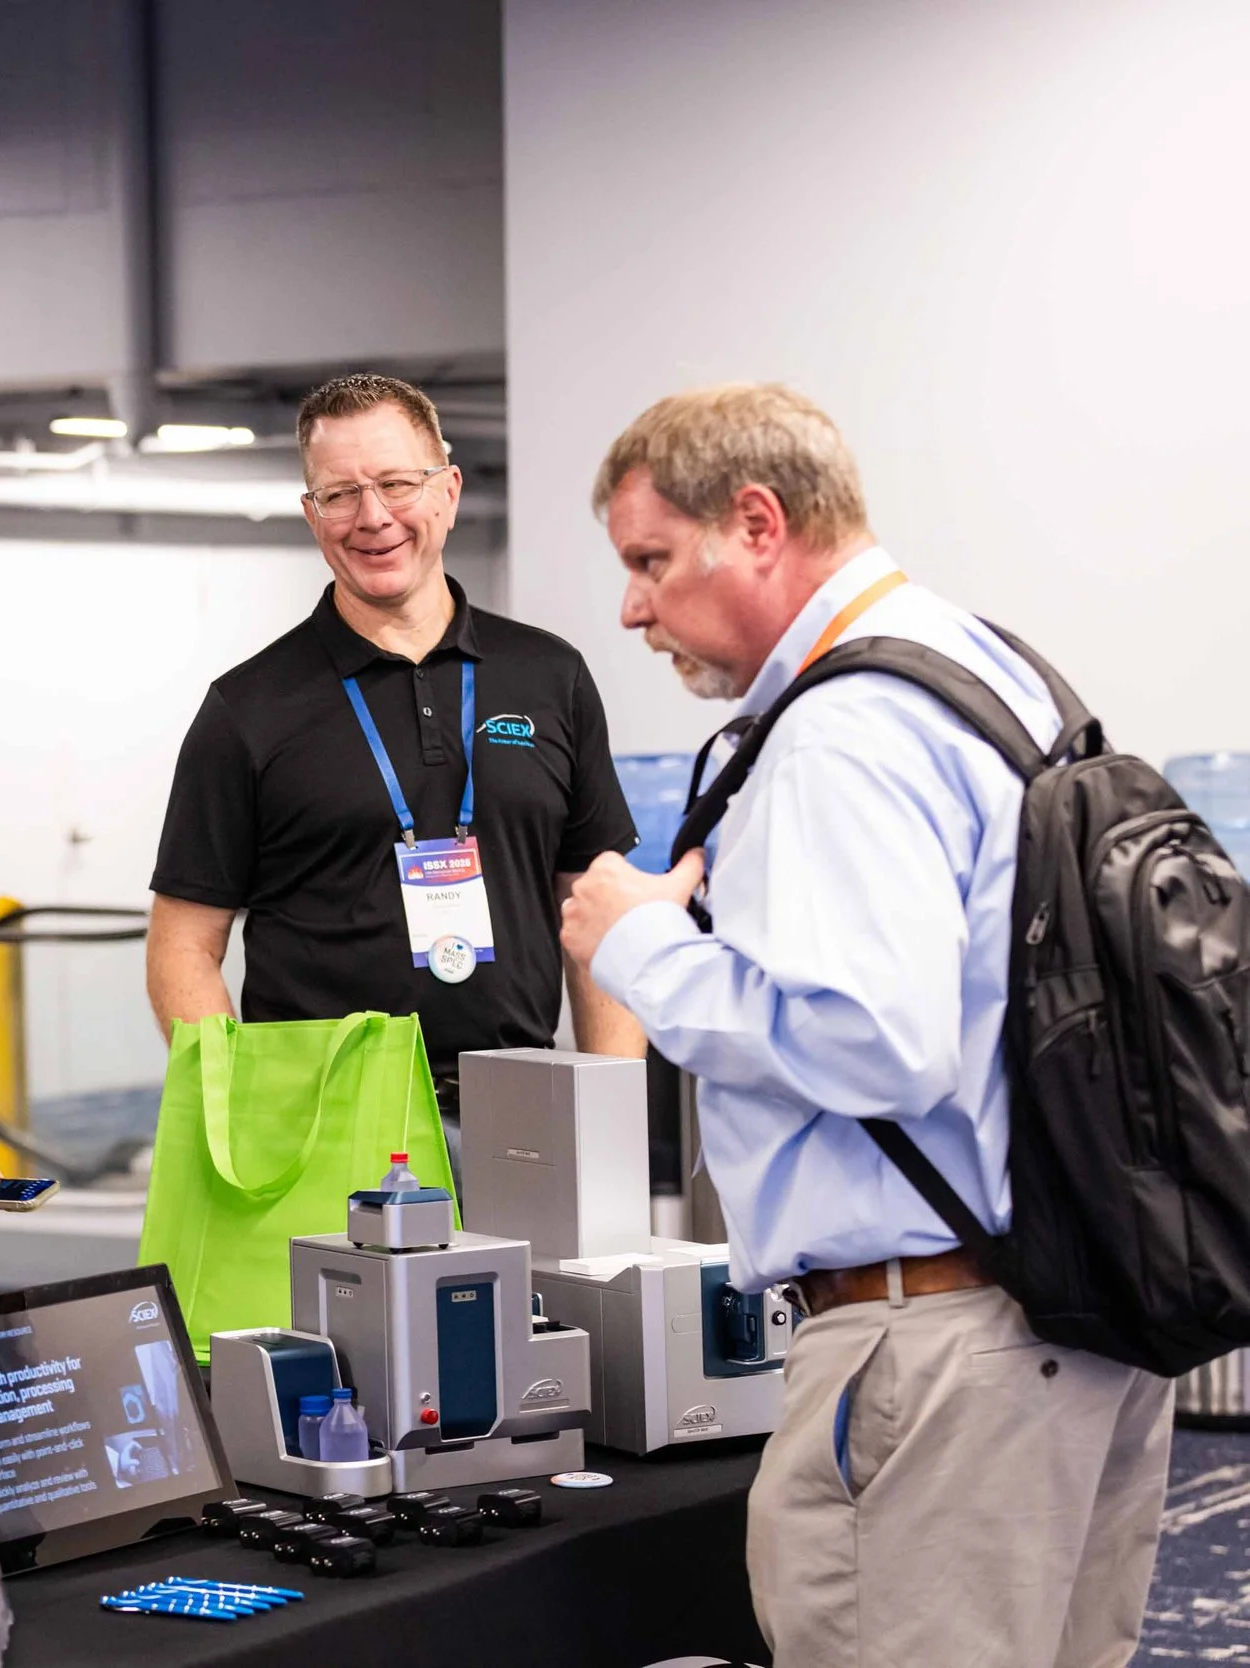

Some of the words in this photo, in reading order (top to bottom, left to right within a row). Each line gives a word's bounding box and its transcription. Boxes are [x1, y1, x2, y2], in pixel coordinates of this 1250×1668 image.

[485, 719, 532, 738] SCIEX
[423, 860, 448, 871] ISSX
[426, 891, 461, 902] RANDY
[7, 1361, 66, 1387] productivity
[65, 1356, 81, 1371] for
[19, 1377, 75, 1403] processing
[59, 1420, 91, 1435] workflows
